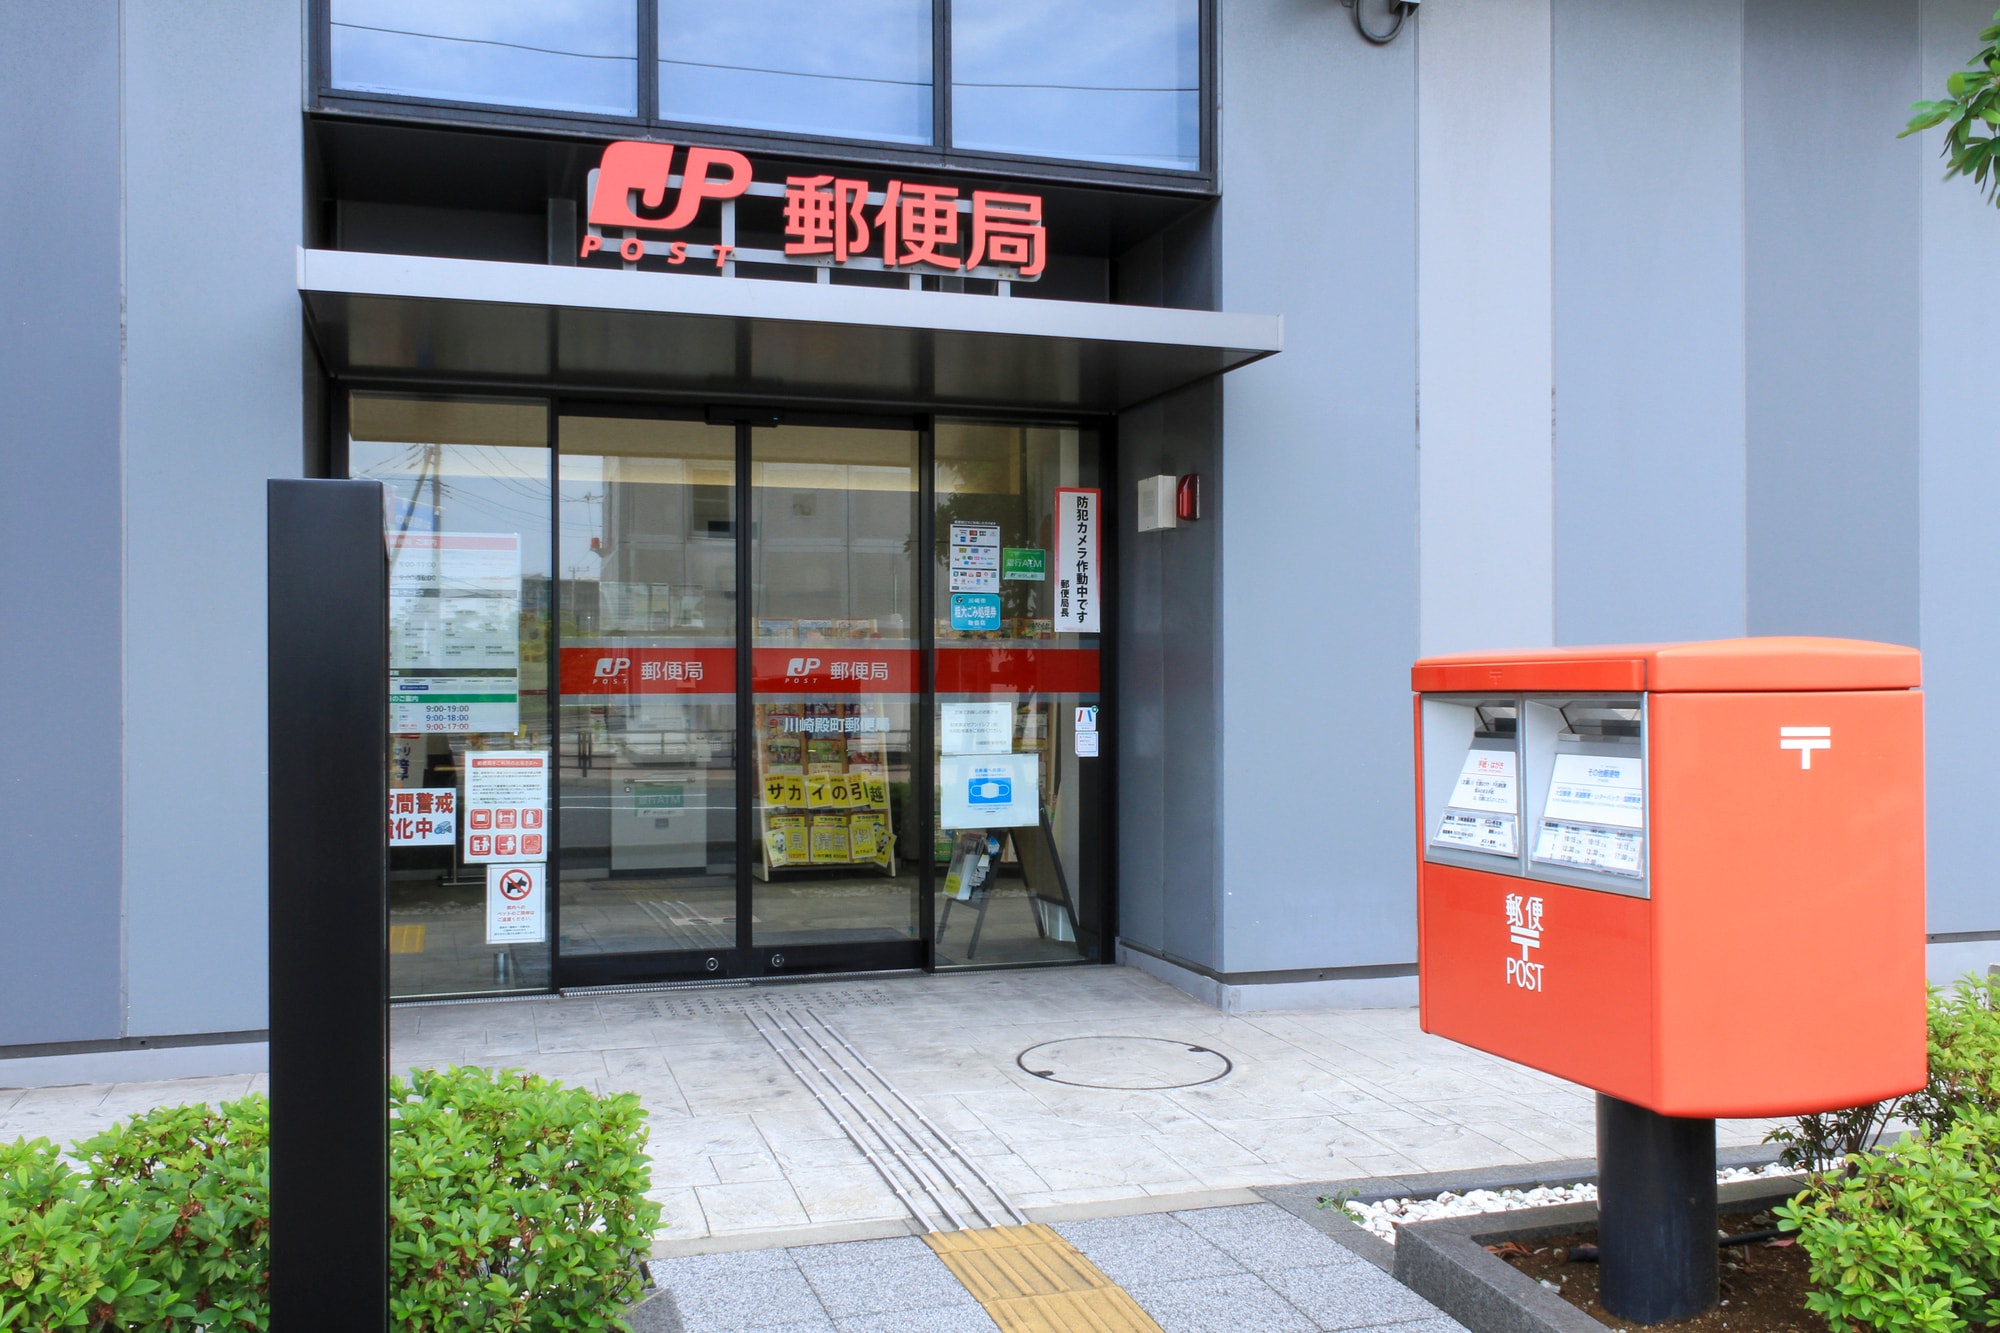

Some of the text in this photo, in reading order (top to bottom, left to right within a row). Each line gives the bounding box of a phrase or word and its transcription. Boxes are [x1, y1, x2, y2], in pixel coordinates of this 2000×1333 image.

[785, 174, 1046, 277] 郵便局
[580, 235, 734, 268] POST
[1076, 496, 1089, 624] 防犯カメラ作動中です
[1060, 579, 1070, 618] 郵便局長
[954, 606, 997, 618] 粗大ごみ処理券
[641, 661, 704, 681] 郵便局
[830, 662, 889, 681] 郵便局
[426, 705, 470, 713] 9:00-19:00
[426, 714, 470, 722] 9:00-18:00
[426, 723, 470, 731] 9:00-17:00
[784, 717, 890, 733] 川崎殿町郵便局
[767, 781, 884, 803] サカイの引越
[1505, 893, 1545, 932] 郵便
[1506, 957, 1545, 993] POST
